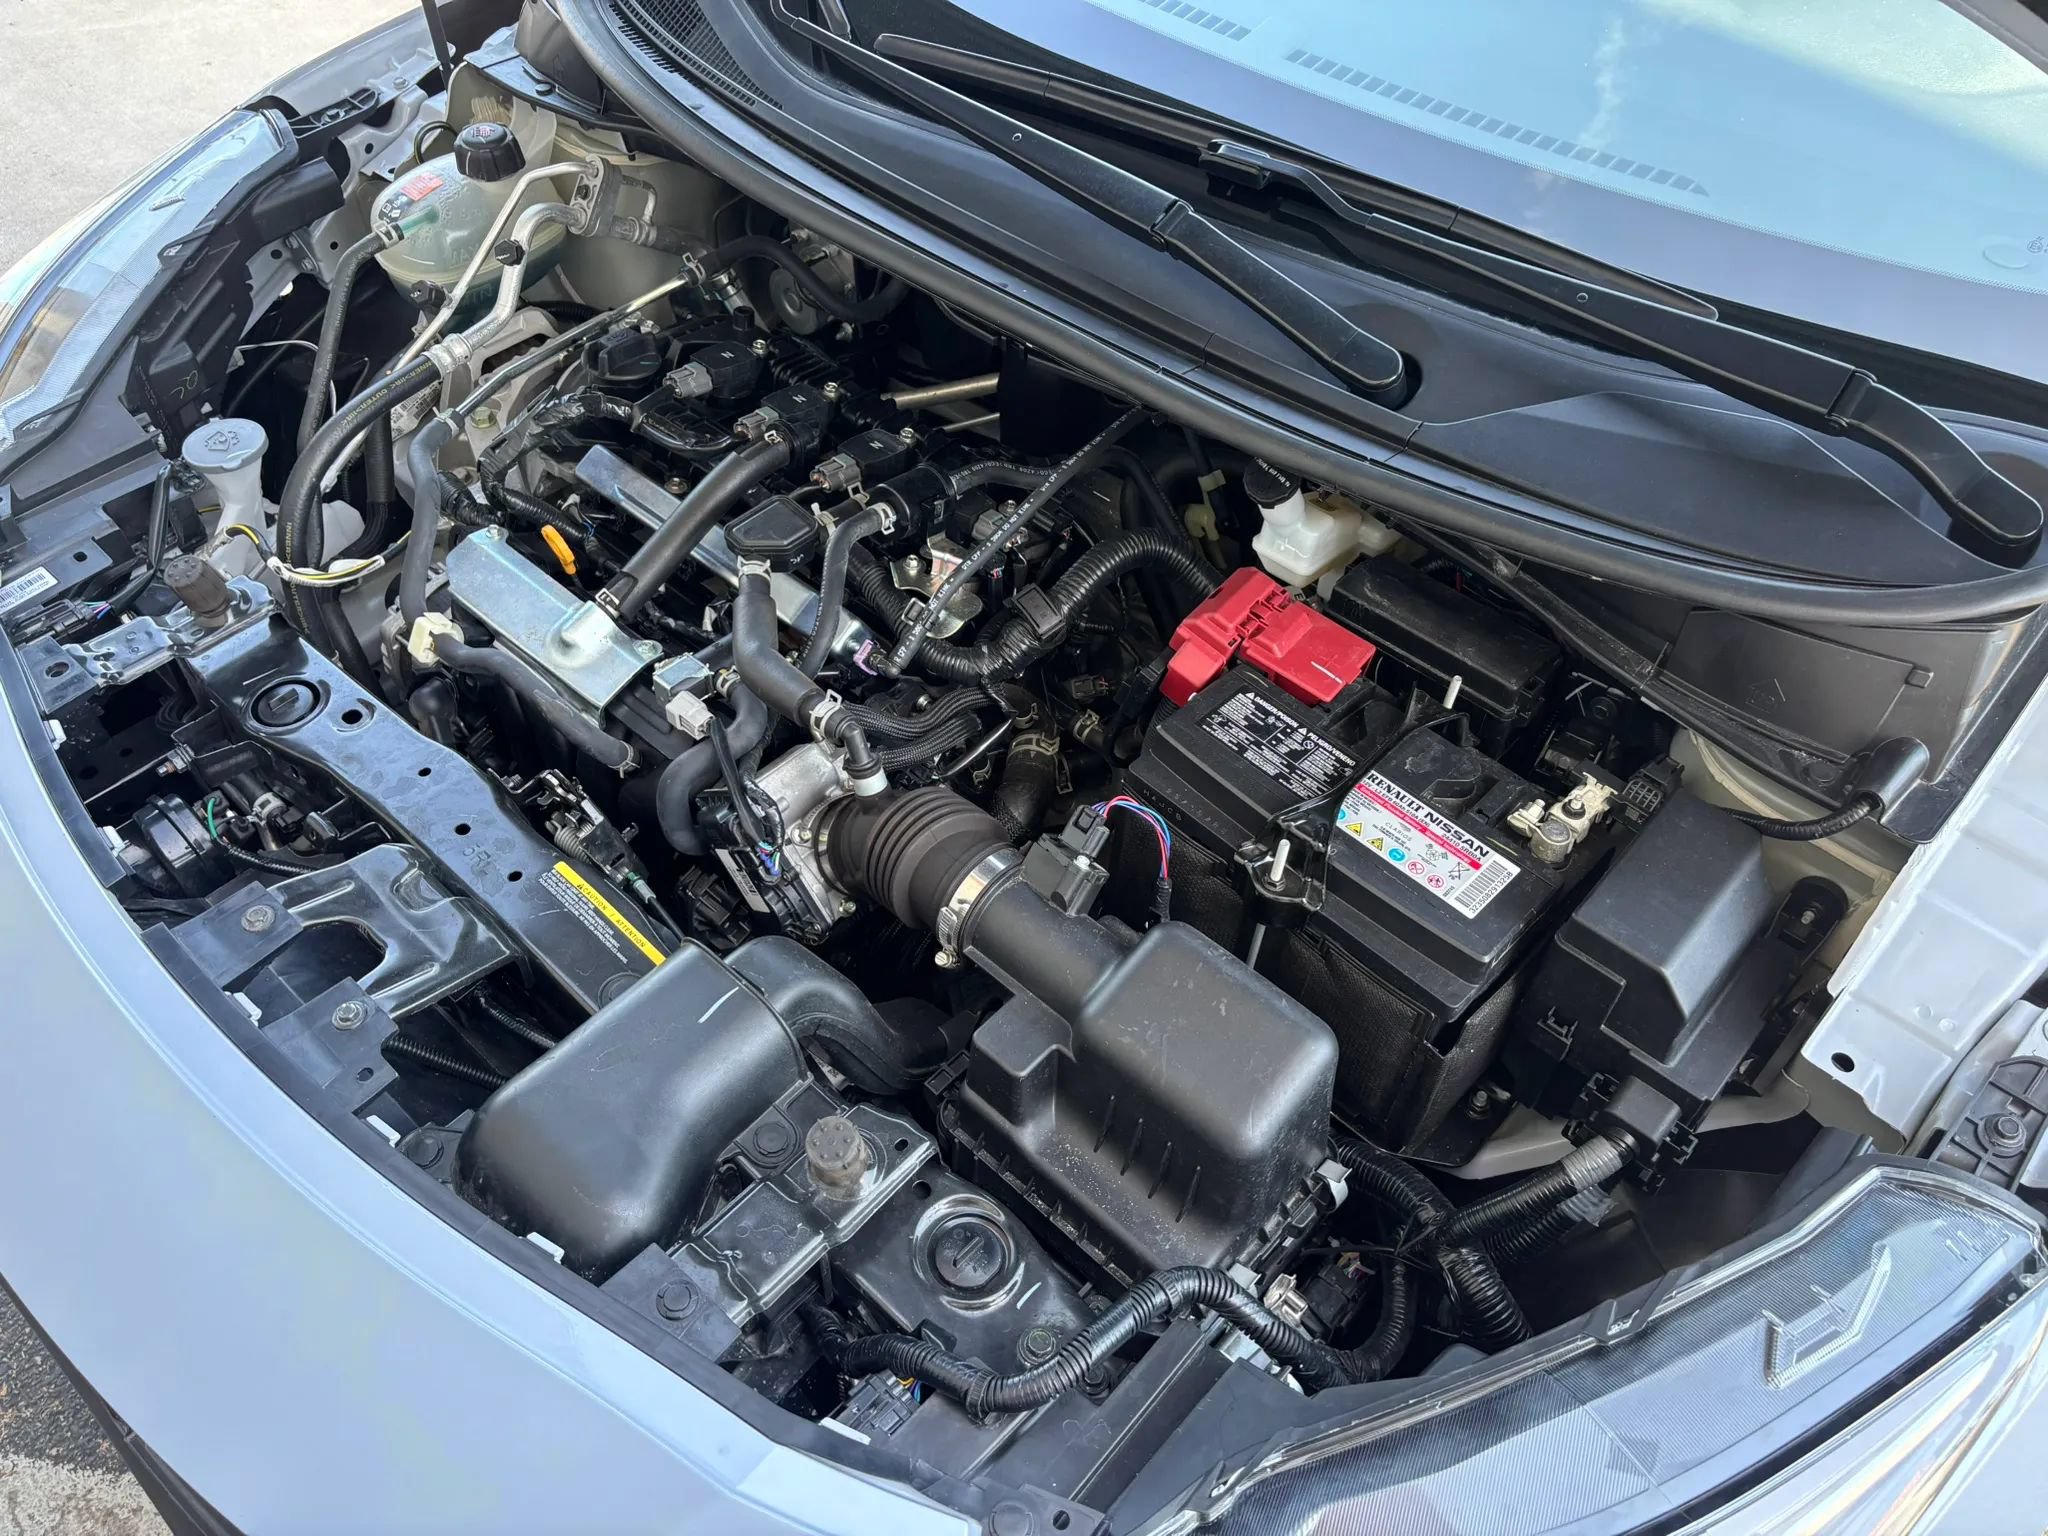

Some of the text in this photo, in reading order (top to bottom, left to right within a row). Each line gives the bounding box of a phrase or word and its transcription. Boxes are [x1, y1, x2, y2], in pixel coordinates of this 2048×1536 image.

[1253, 696, 1298, 727] DANGER/POISON
[1306, 732, 1356, 766] PELIGRO/VENENO
[1366, 772, 1424, 814] RENAULT
[1425, 811, 1490, 858] NISSAN
[1384, 821, 1412, 841] CLARIOS
[582, 887, 607, 910] CAUTION
[614, 918, 646, 947] ATTENTION
